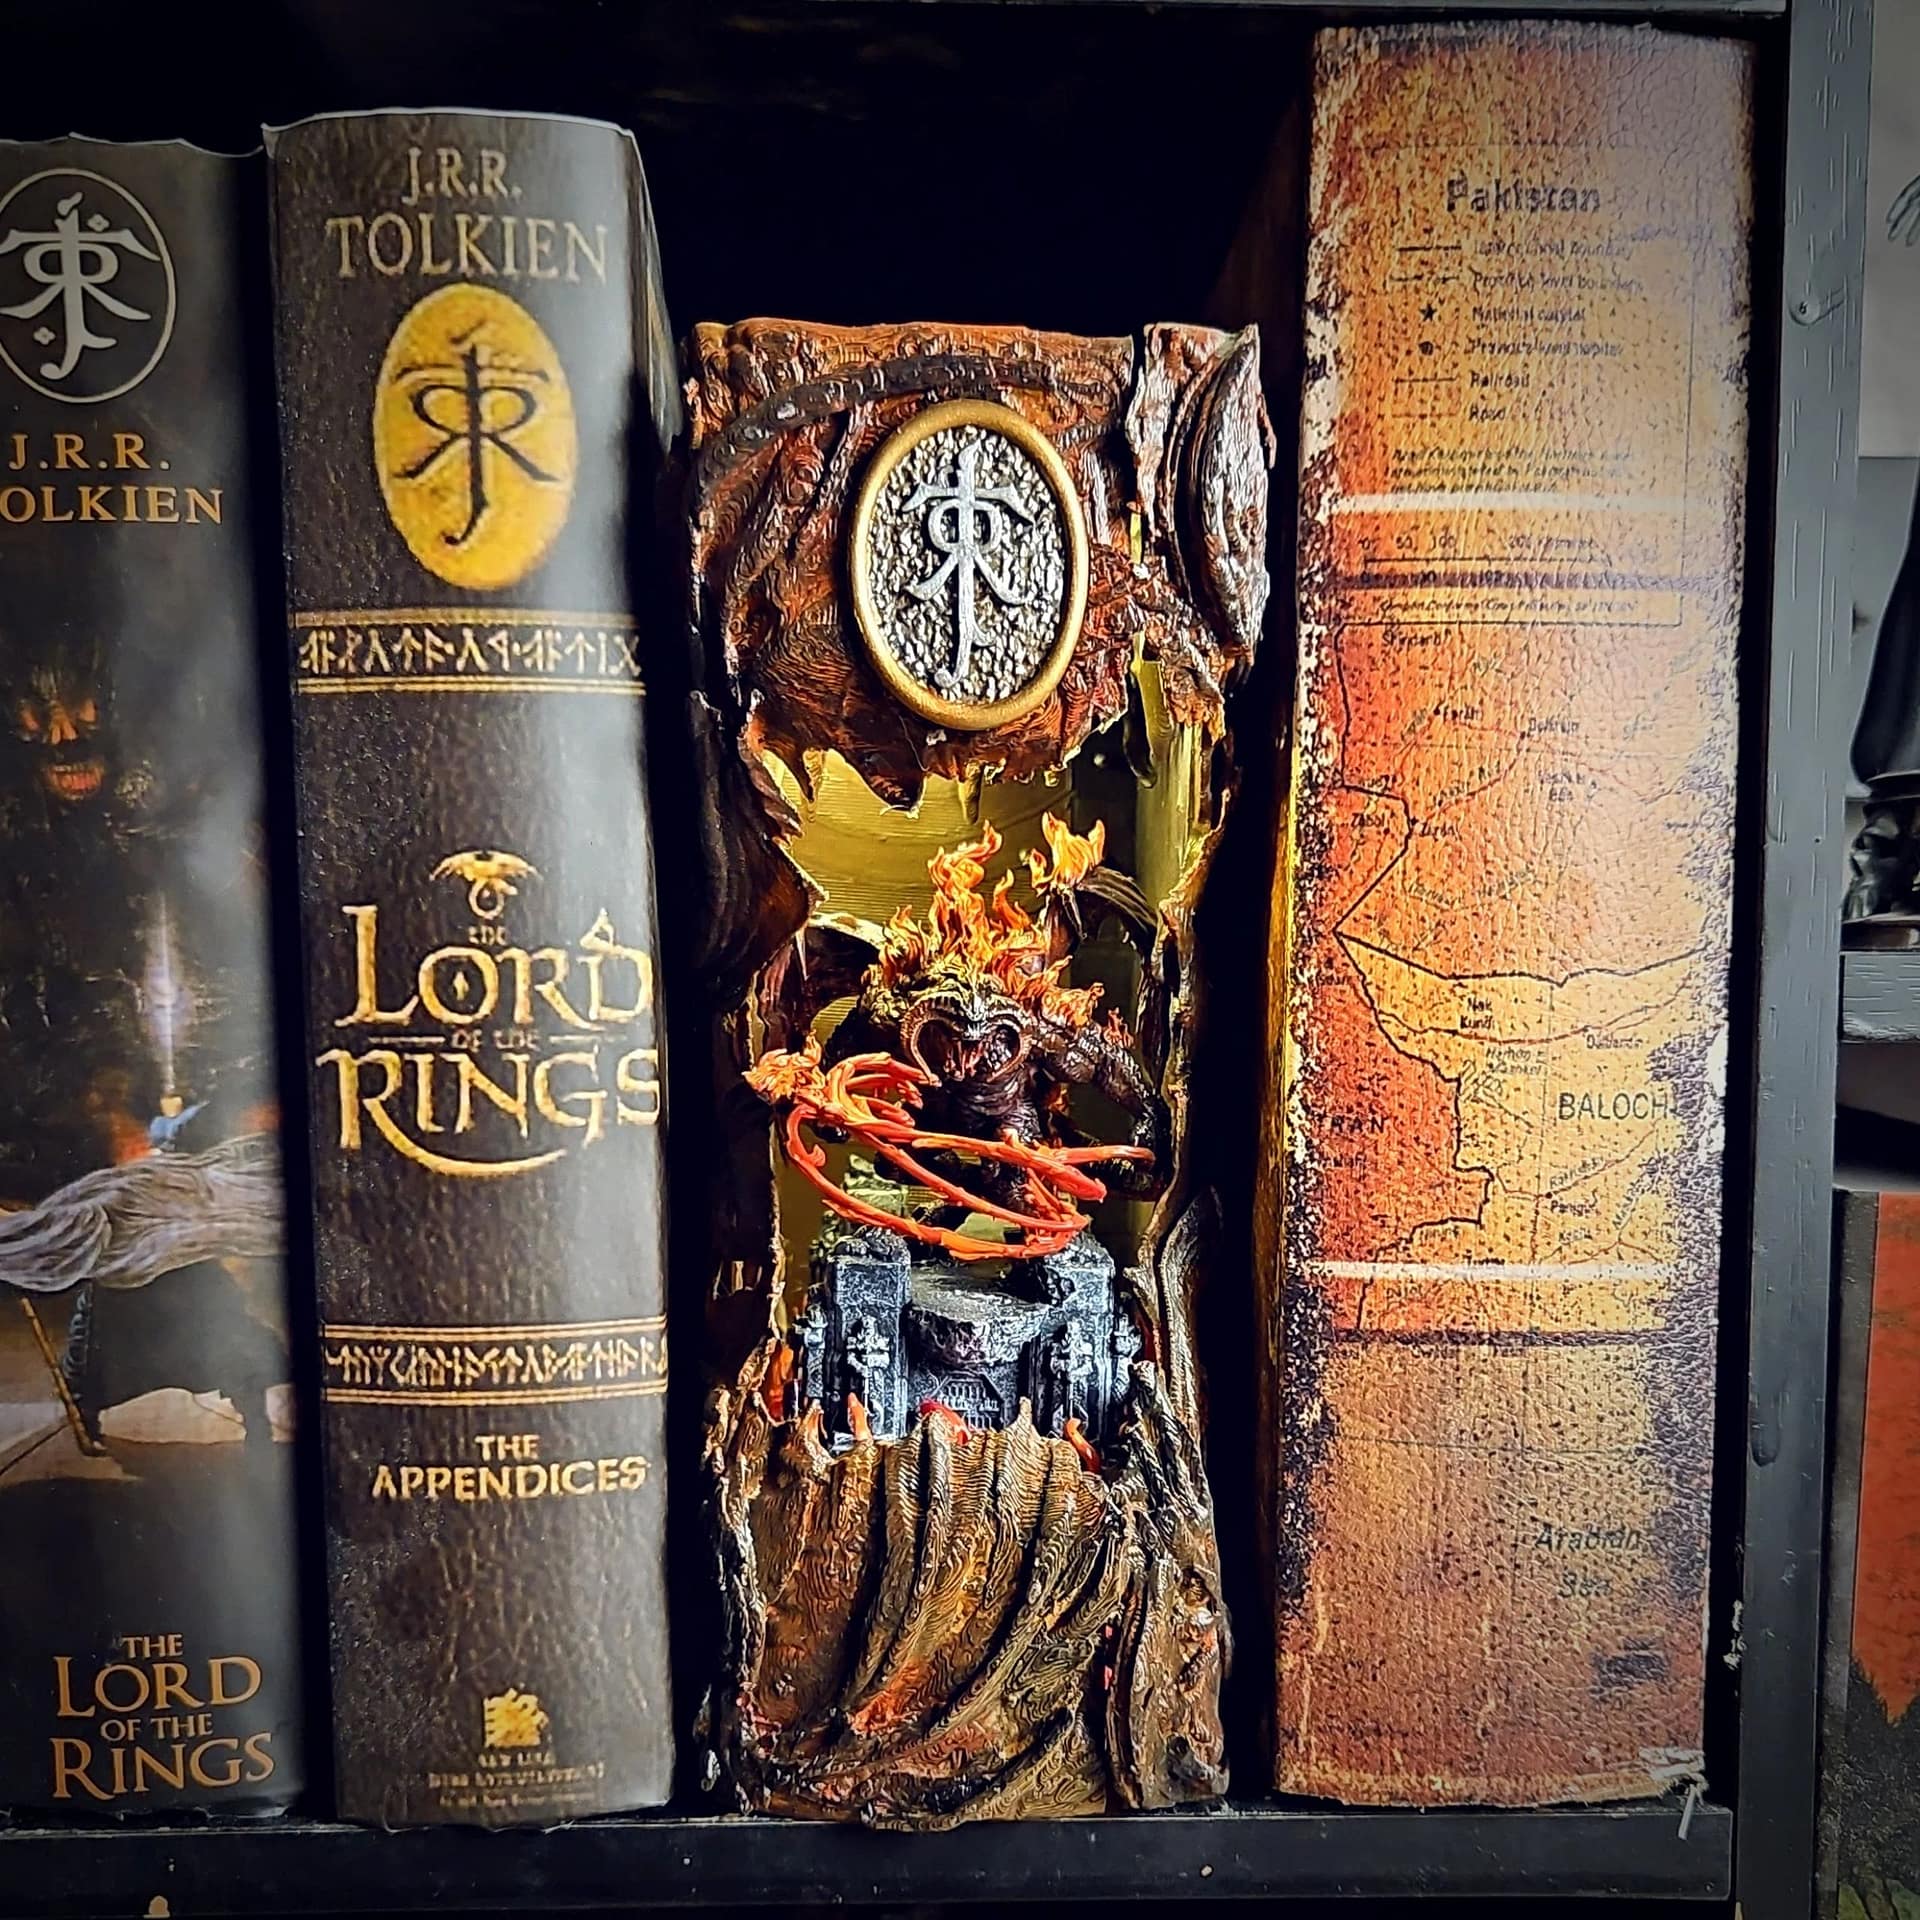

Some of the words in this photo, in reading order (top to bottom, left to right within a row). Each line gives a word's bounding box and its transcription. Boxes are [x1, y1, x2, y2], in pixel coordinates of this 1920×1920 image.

[401, 147, 523, 205] J.R.R.
[324, 213, 609, 285] TOLKIEN
[8, 433, 171, 471] J.R.R.
[333, 904, 656, 1032] LORD
[315, 1044, 662, 1178] RINGS
[475, 1434, 540, 1461] THE
[371, 1455, 650, 1501] APPENDICES
[119, 1633, 184, 1660] THE
[52, 1655, 263, 1719] LORD
[101, 1718, 142, 1743] OF
[149, 1712, 214, 1740] THE
[49, 1732, 275, 1800] RINGS
